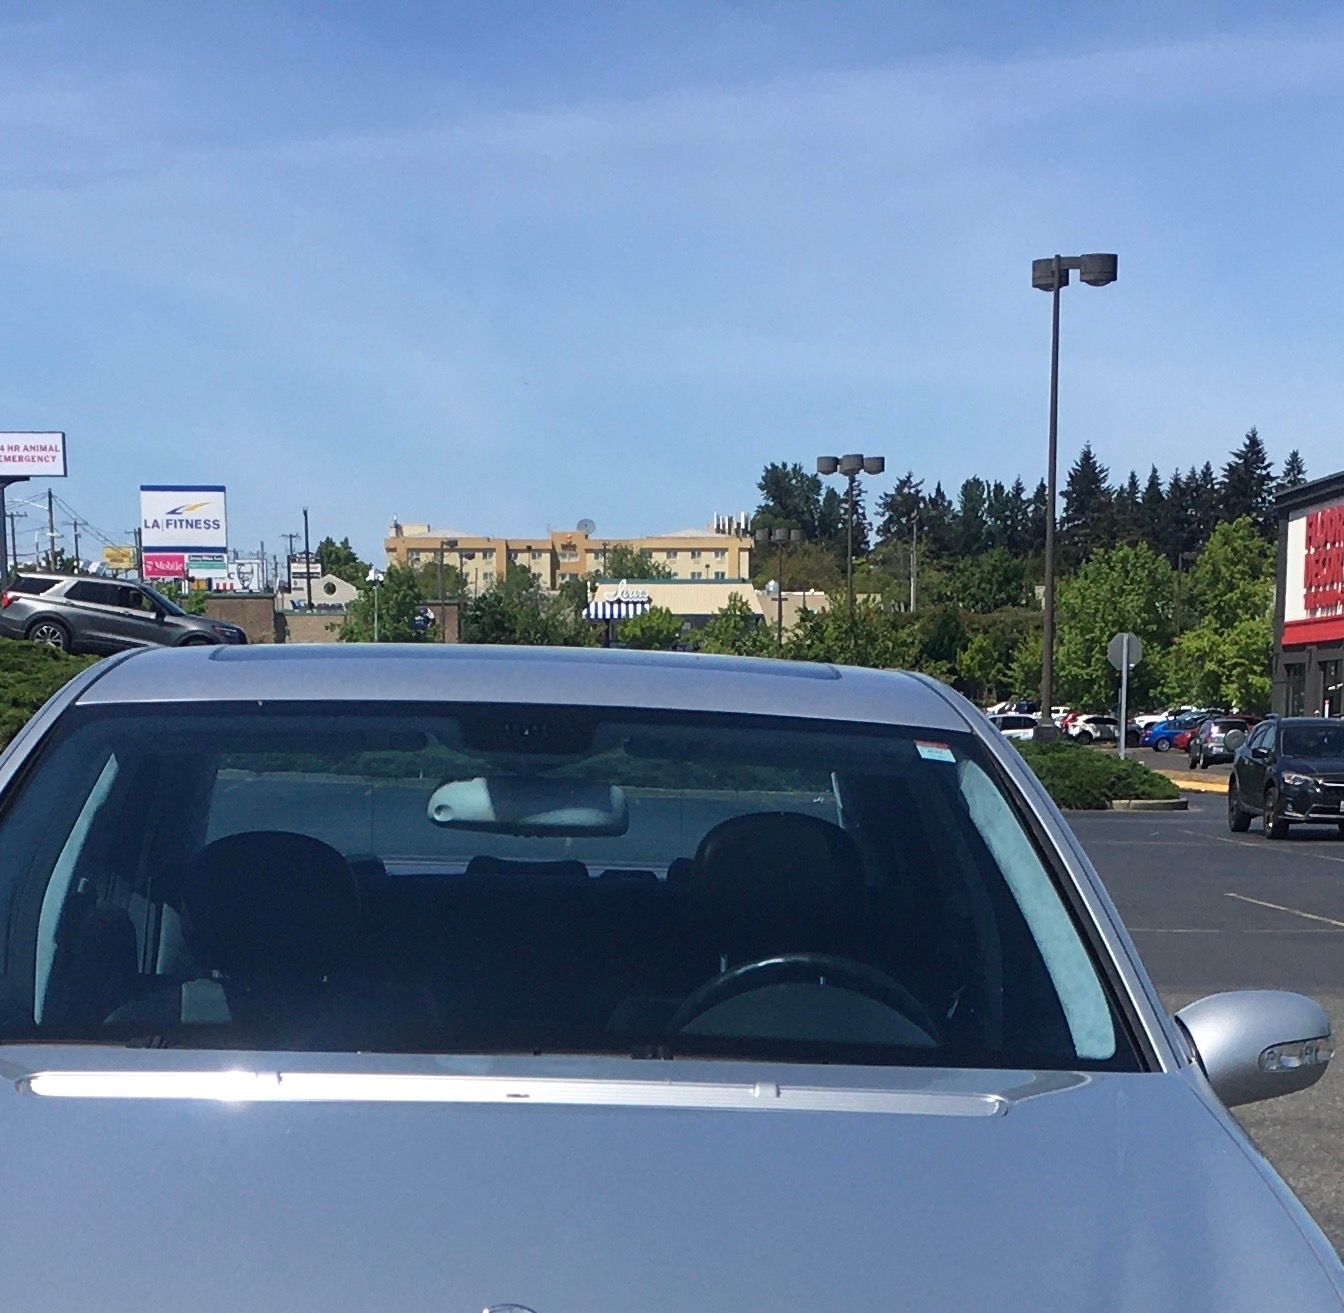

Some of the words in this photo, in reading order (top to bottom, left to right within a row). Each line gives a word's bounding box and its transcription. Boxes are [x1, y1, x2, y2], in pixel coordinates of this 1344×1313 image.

[7, 444, 20, 452] HR
[22, 444, 60, 452] ANIMAL
[144, 519, 160, 529] LA
[165, 519, 220, 530] FITNESS
